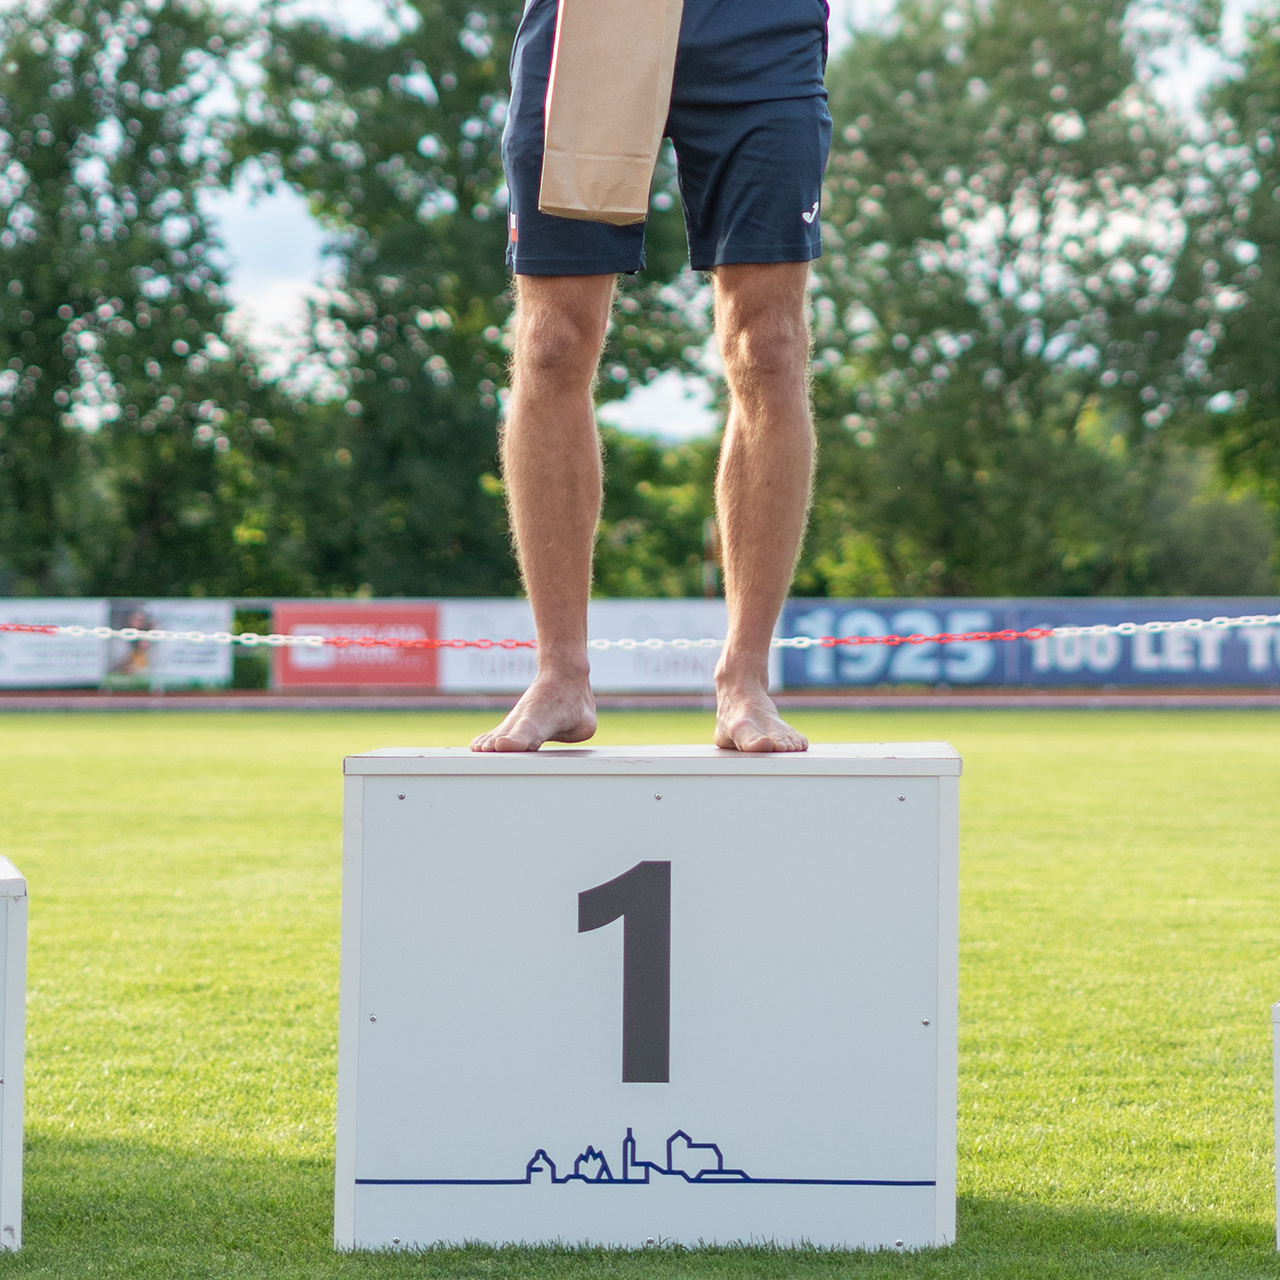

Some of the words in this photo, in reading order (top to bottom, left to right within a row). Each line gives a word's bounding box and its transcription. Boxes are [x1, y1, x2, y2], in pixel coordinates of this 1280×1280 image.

[794, 607, 998, 684] 1925
[1030, 622, 1122, 672] 100
[1132, 624, 1226, 671] LET
[577, 860, 672, 1084] 1
